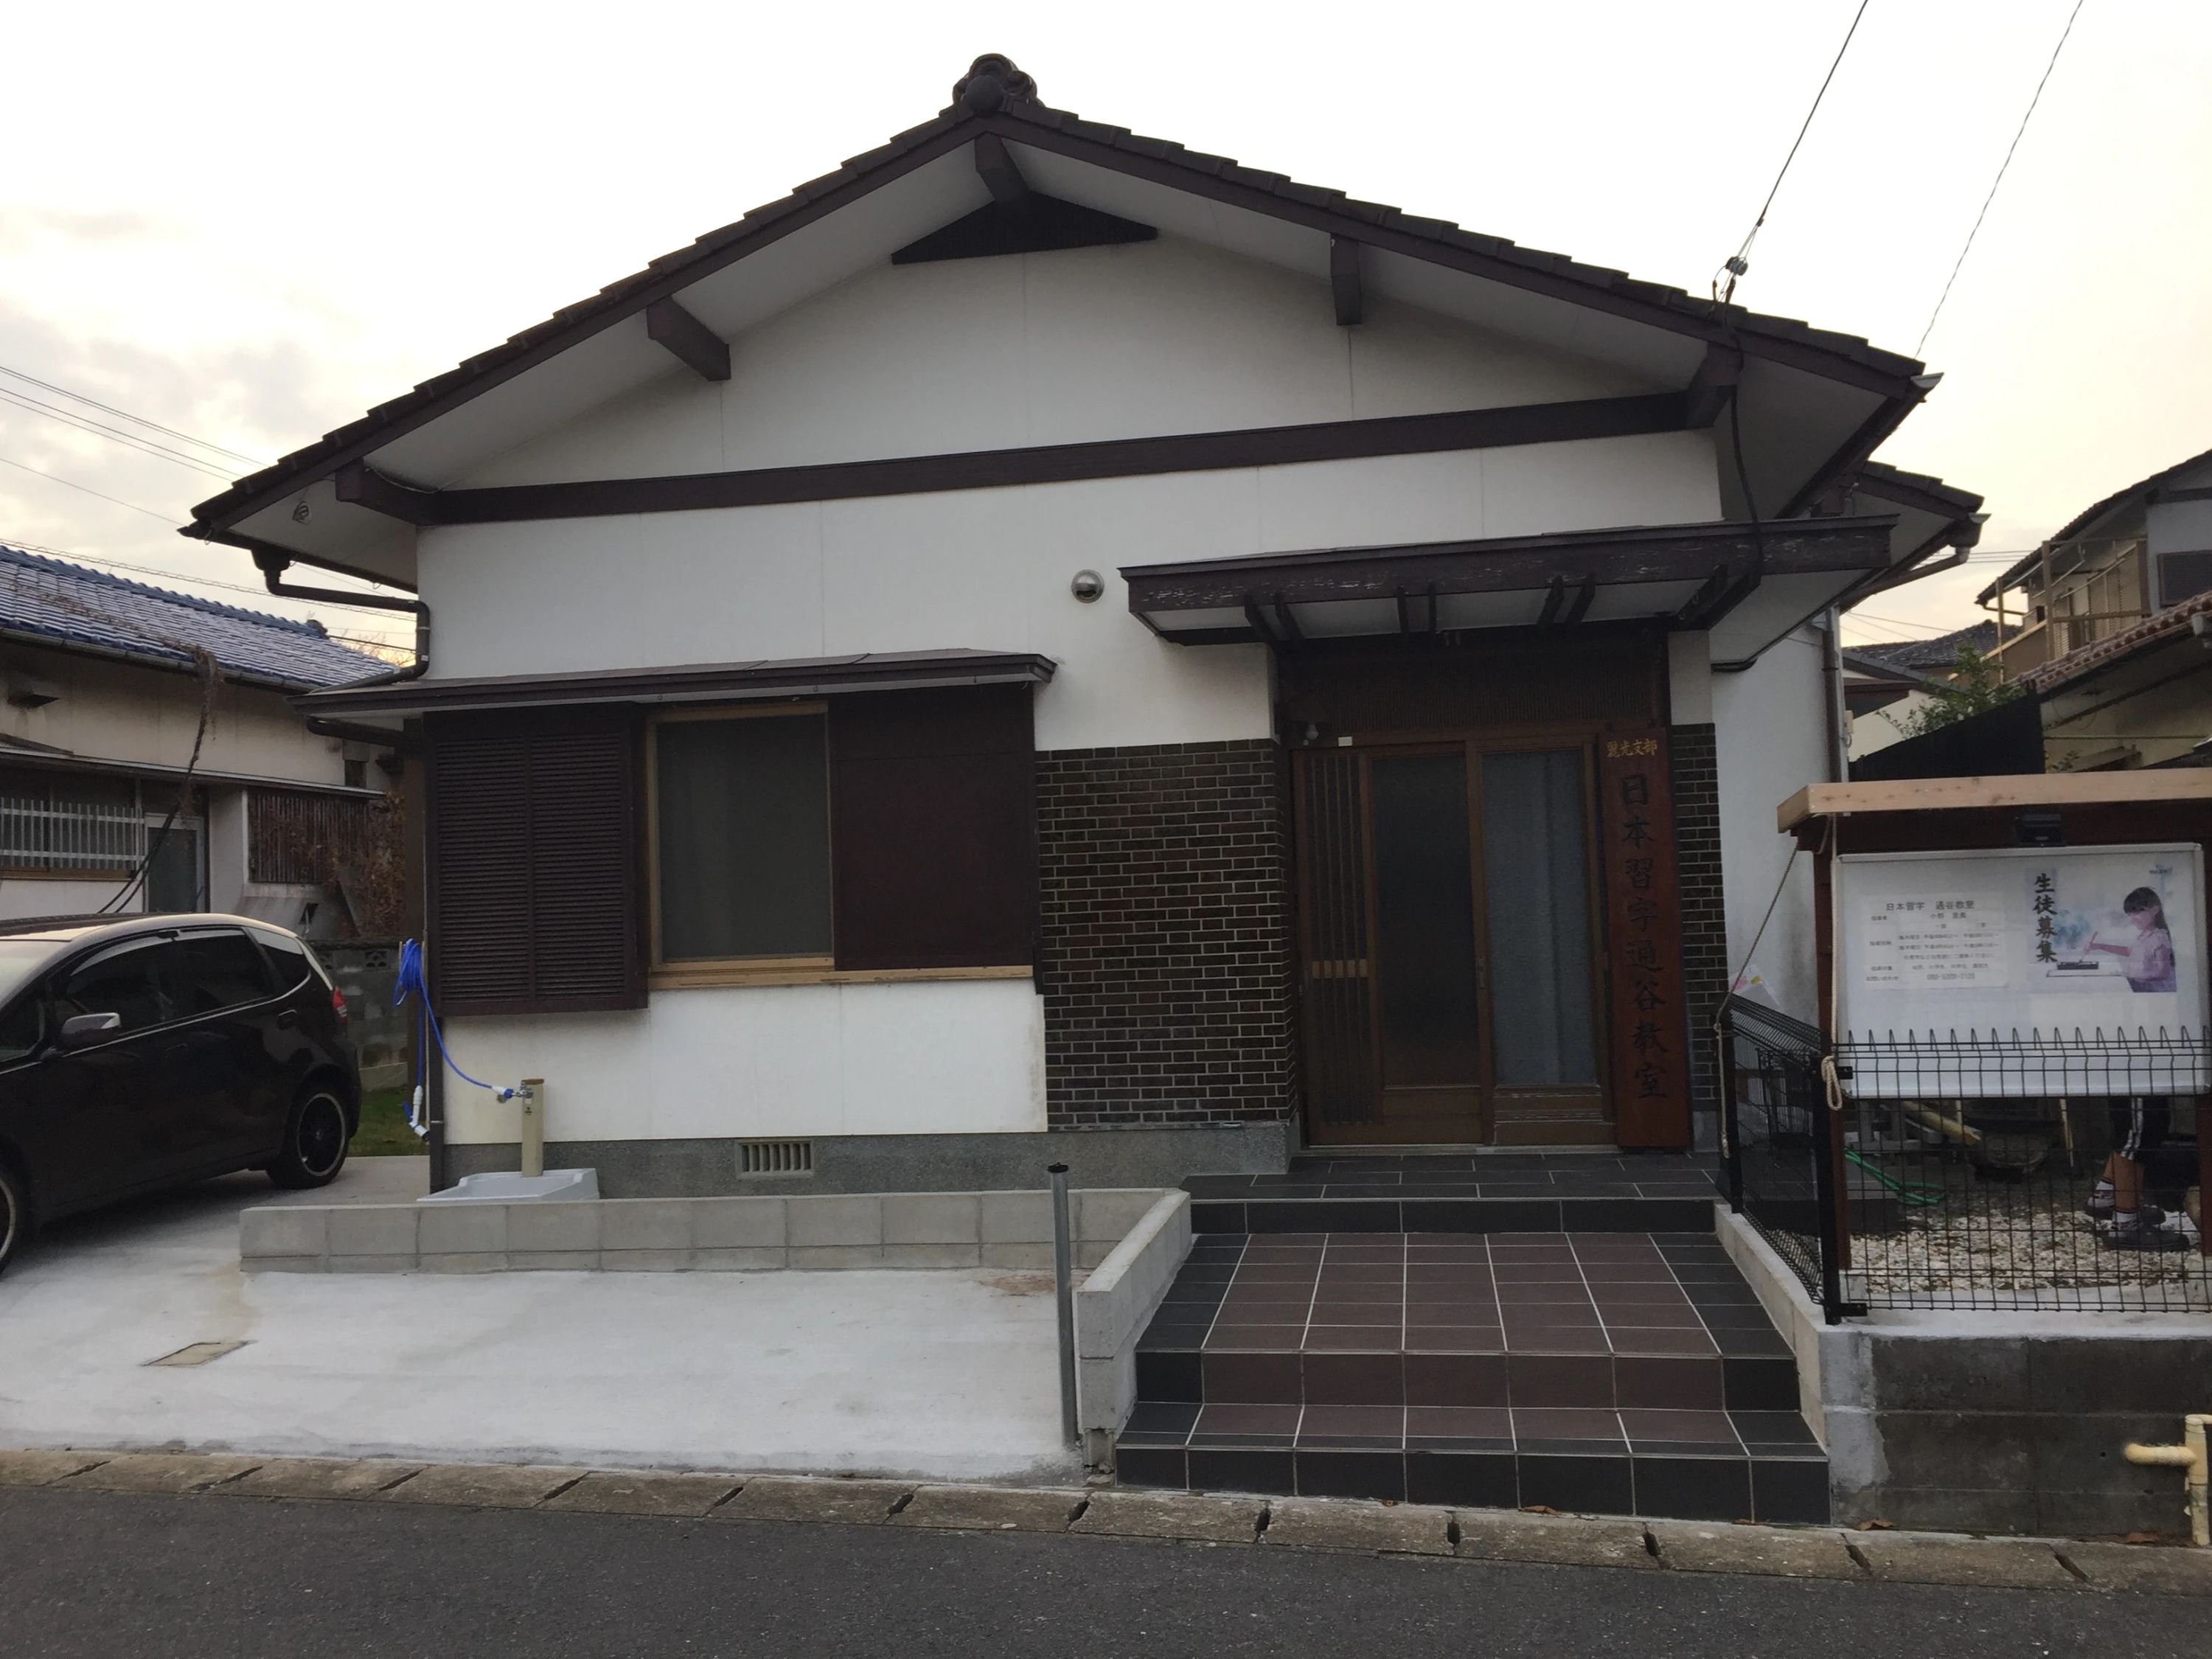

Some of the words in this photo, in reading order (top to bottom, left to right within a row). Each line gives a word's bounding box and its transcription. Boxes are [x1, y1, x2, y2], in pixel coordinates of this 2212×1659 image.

[1622, 774, 1669, 1099] 日本習字通谷教室
[2032, 872, 2058, 963] 生徒募集
